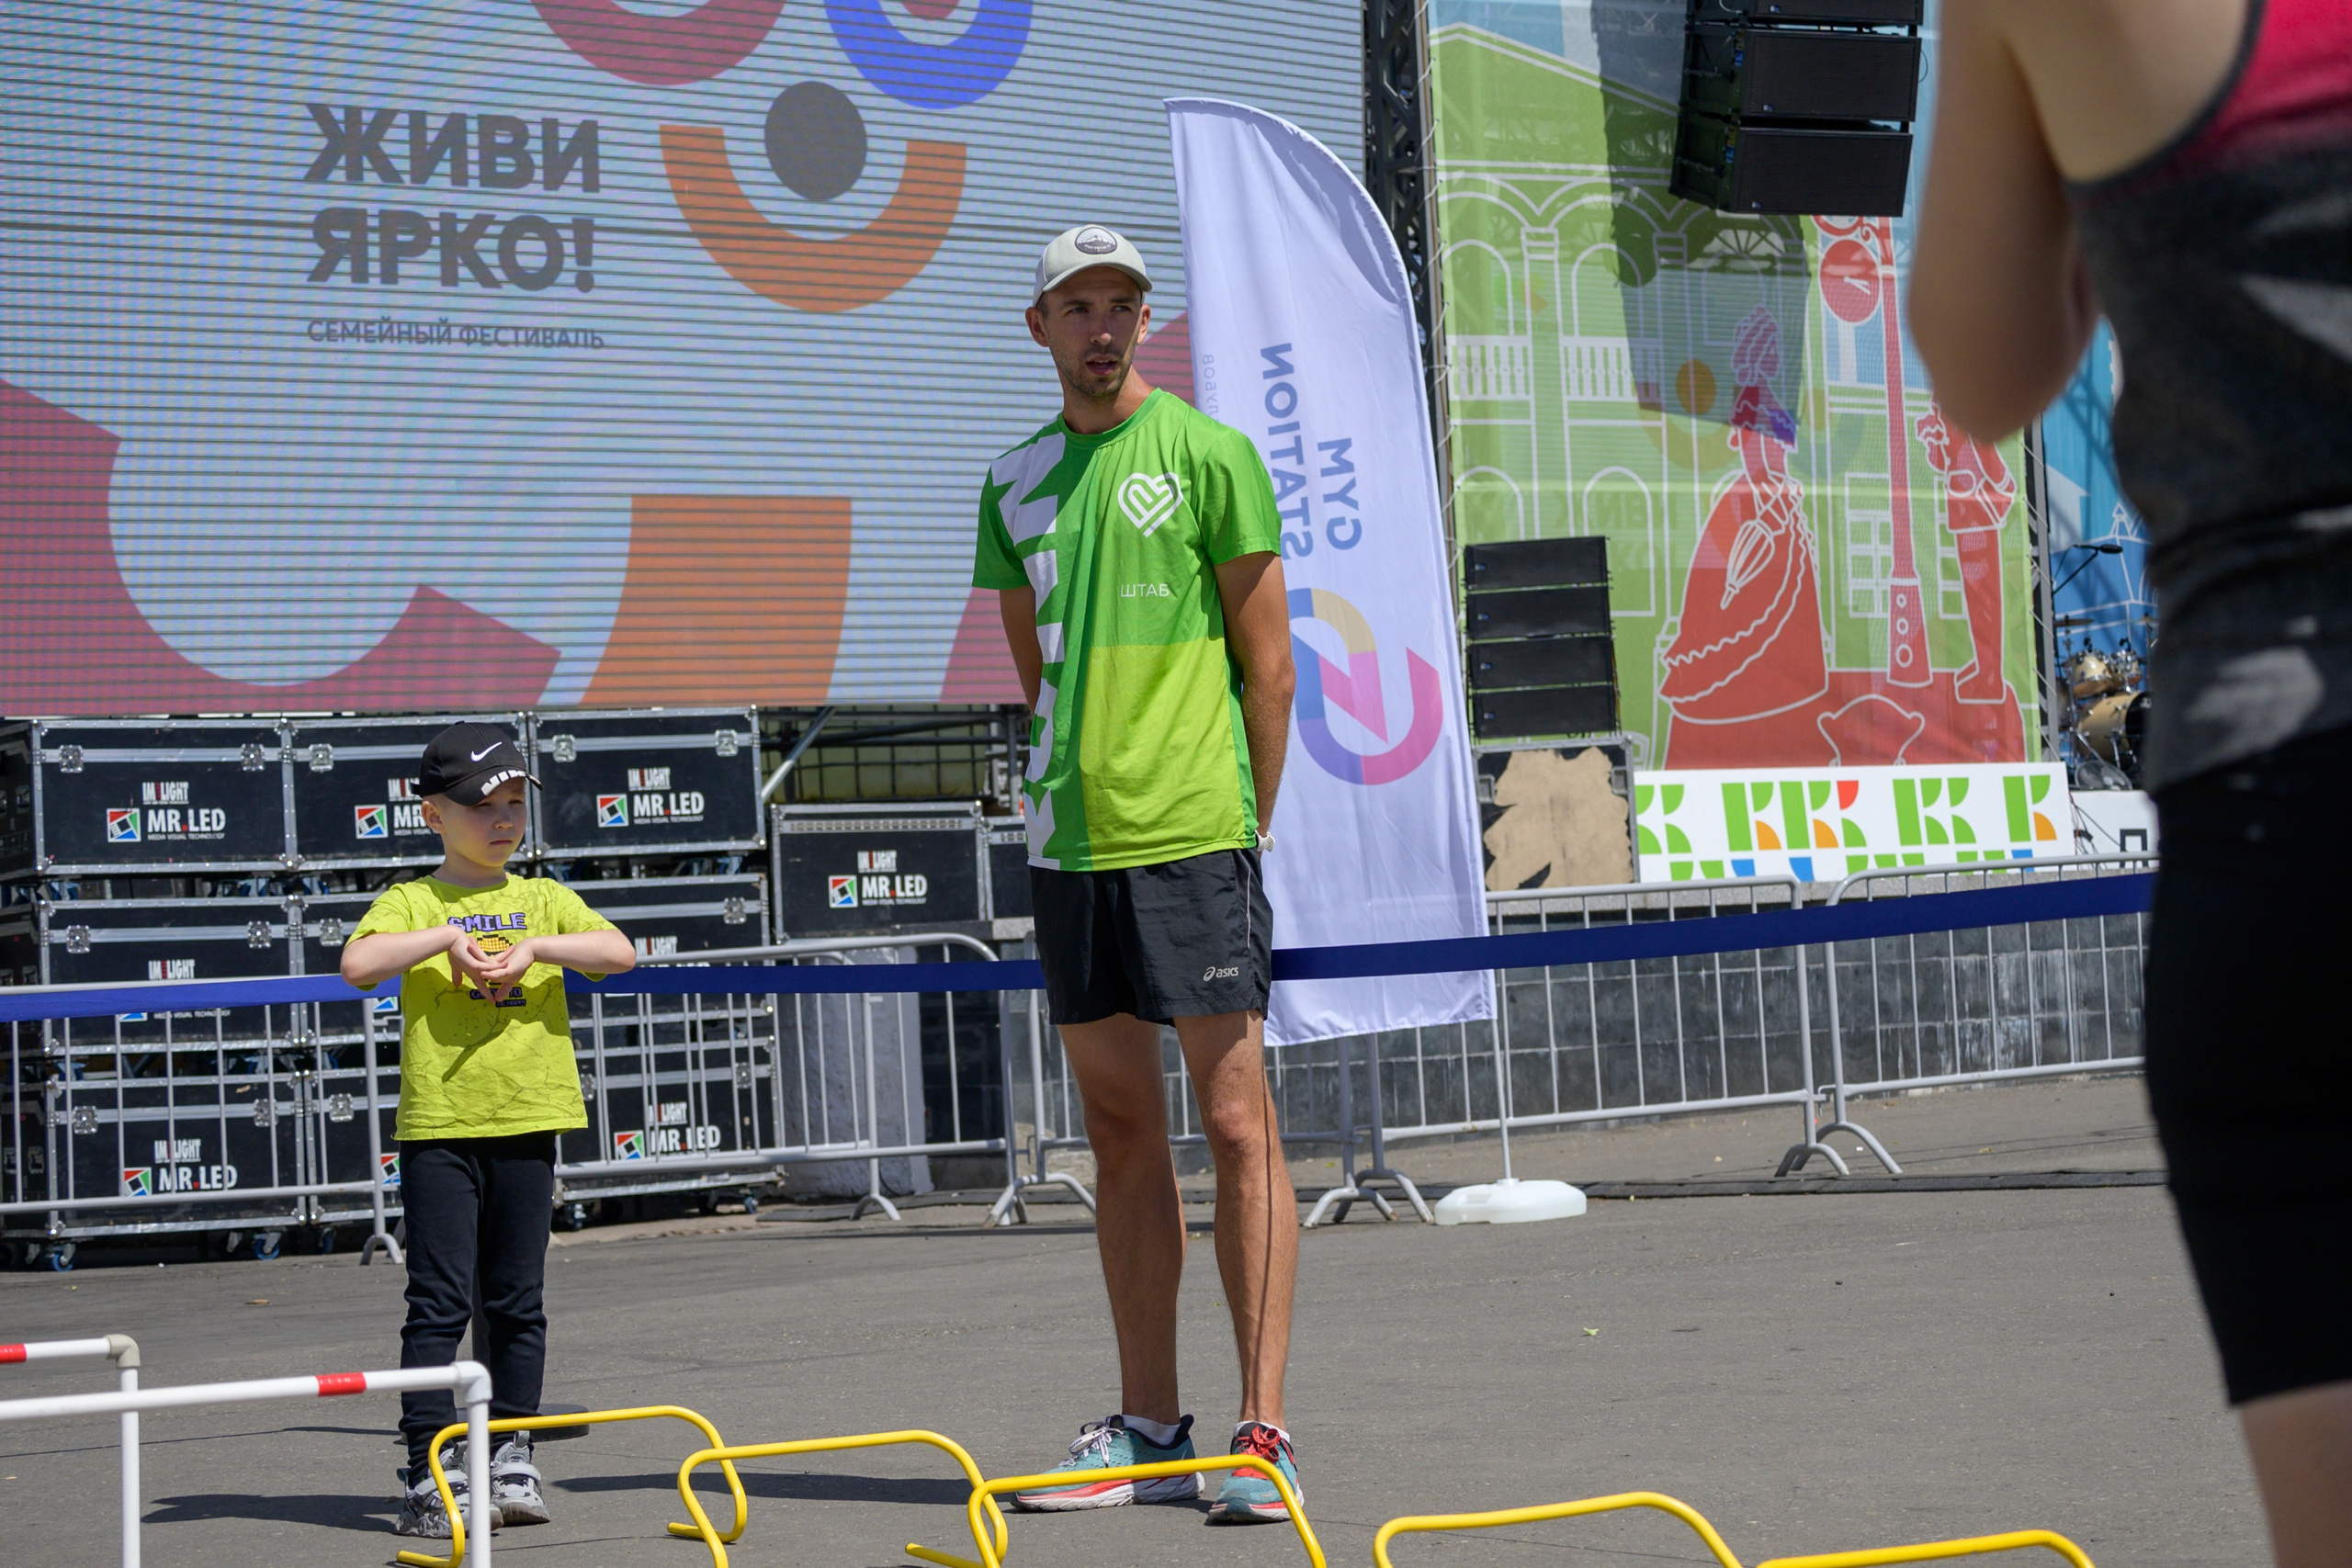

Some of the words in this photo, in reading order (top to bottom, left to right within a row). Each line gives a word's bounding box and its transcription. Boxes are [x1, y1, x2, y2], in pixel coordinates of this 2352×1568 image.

[303, 104, 601, 193] ЖИВИ
[307, 207, 595, 293] ЯРКО!
[307, 315, 452, 345] СЕМЕЙНЫЙ
[459, 322, 604, 349] ФЕСТИВАЛЬ
[1120, 583, 1170, 597] ШТАБ
[633, 791, 705, 818] MR.LED
[148, 808, 226, 832] MR.LED
[862, 875, 928, 898] MR.LED
[447, 912, 527, 933] SMILE
[1216, 966, 1239, 978] asics
